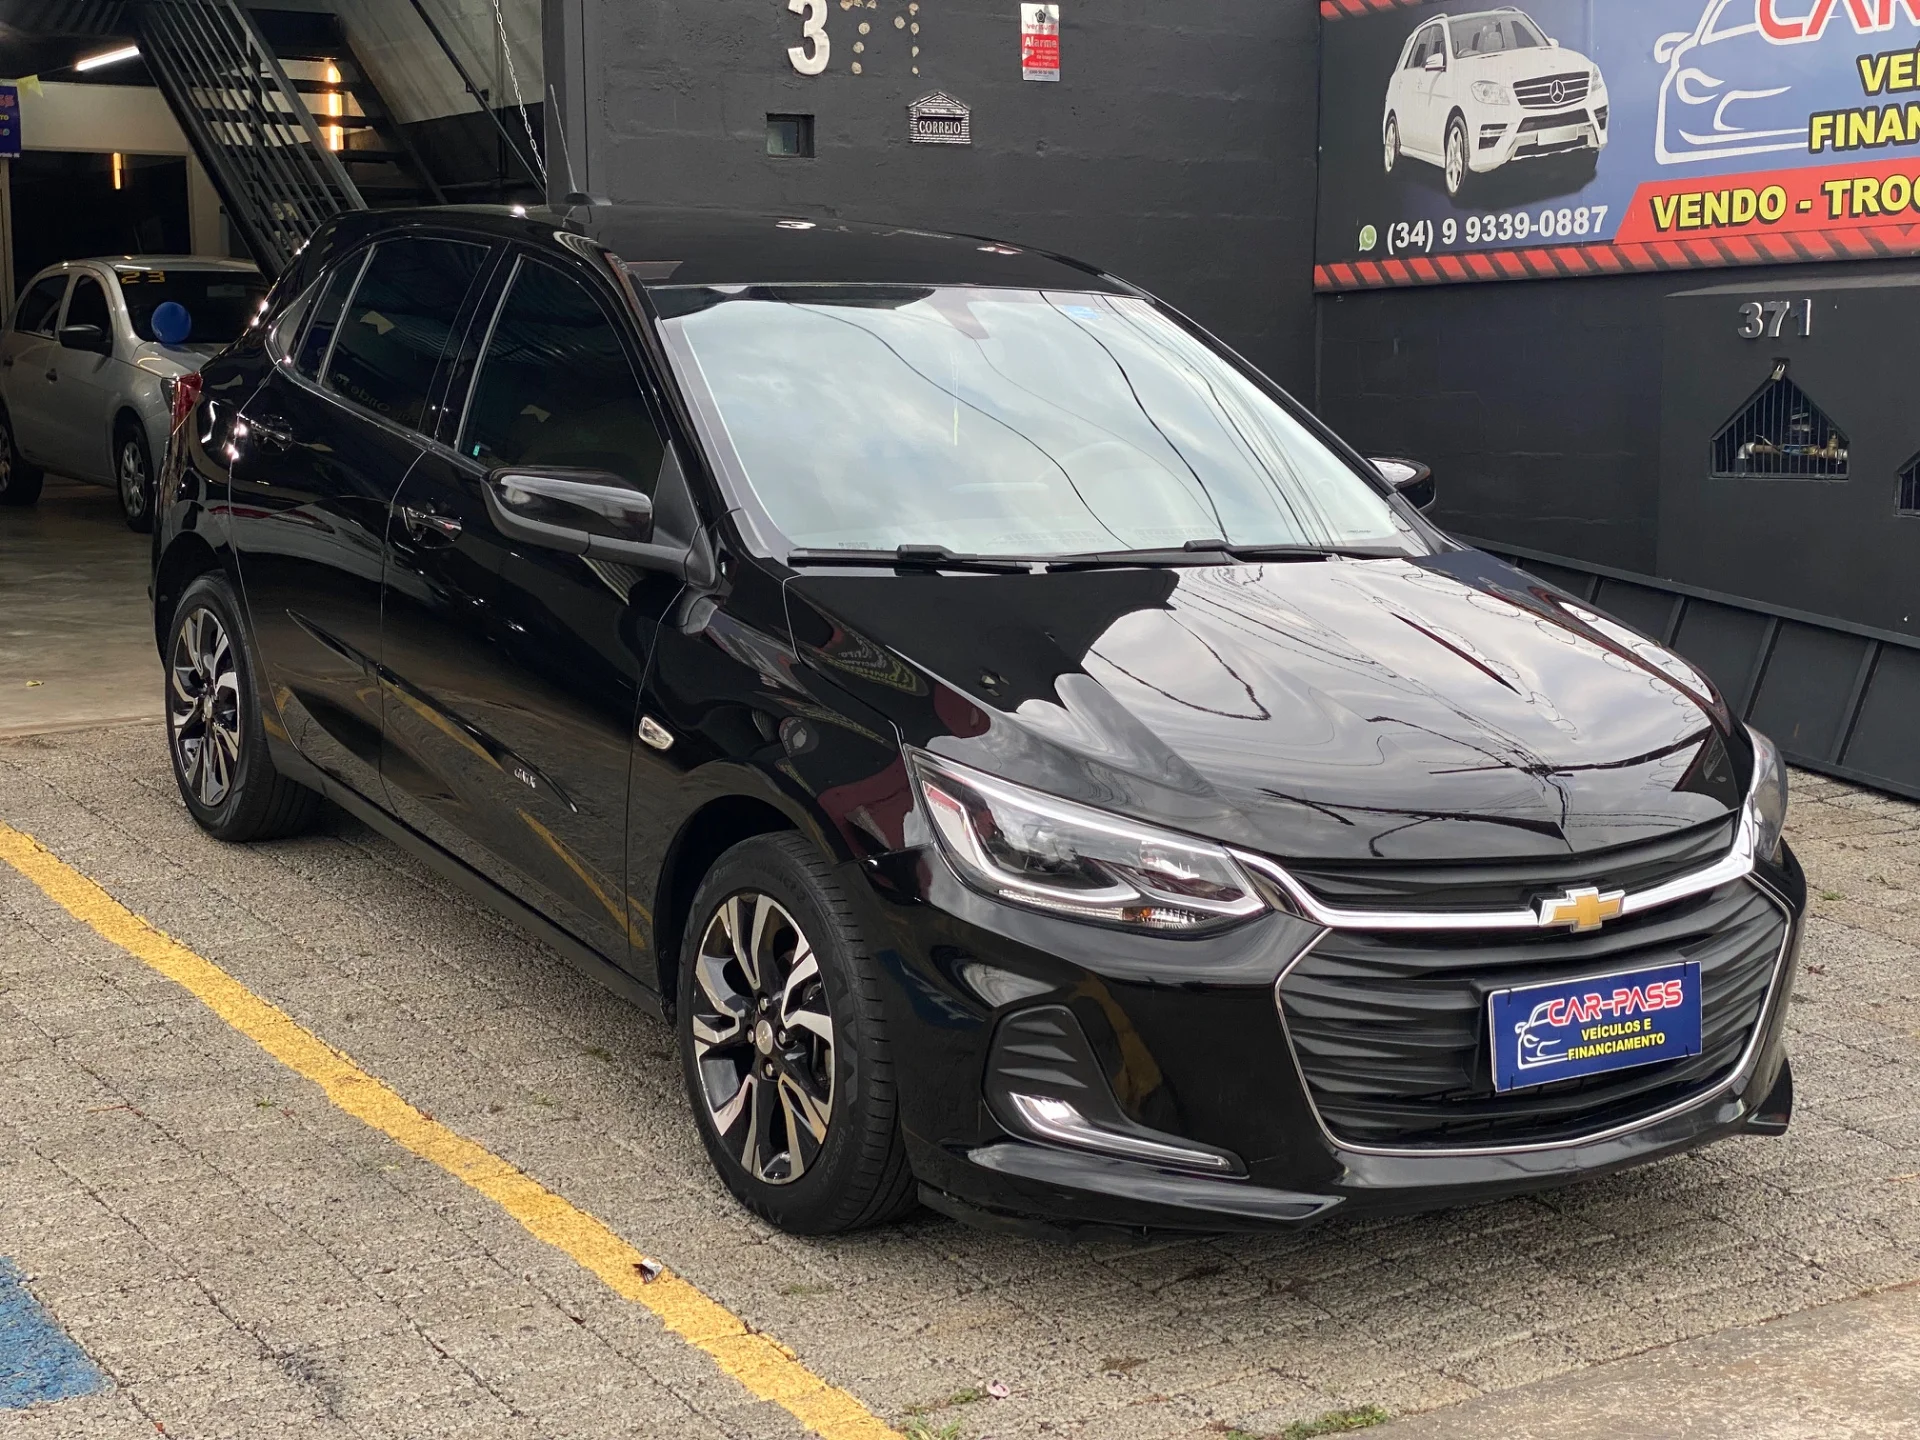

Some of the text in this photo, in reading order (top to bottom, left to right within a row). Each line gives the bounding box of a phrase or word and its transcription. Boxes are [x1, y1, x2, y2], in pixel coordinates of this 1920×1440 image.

[1024, 35, 1057, 48] Alarme
[918, 119, 961, 135] CORREIO
[1652, 185, 1788, 230] VENDO
[1824, 174, 1920, 217] TRO
[1387, 205, 1609, 255] (34) 9 9339-0887
[1737, 299, 1811, 339] 371
[1547, 979, 1684, 1027] CAR-PASS
[1567, 1032, 1666, 1061] FINANCIAMENTO
[1581, 1018, 1652, 1041] VEÍCULOS E
